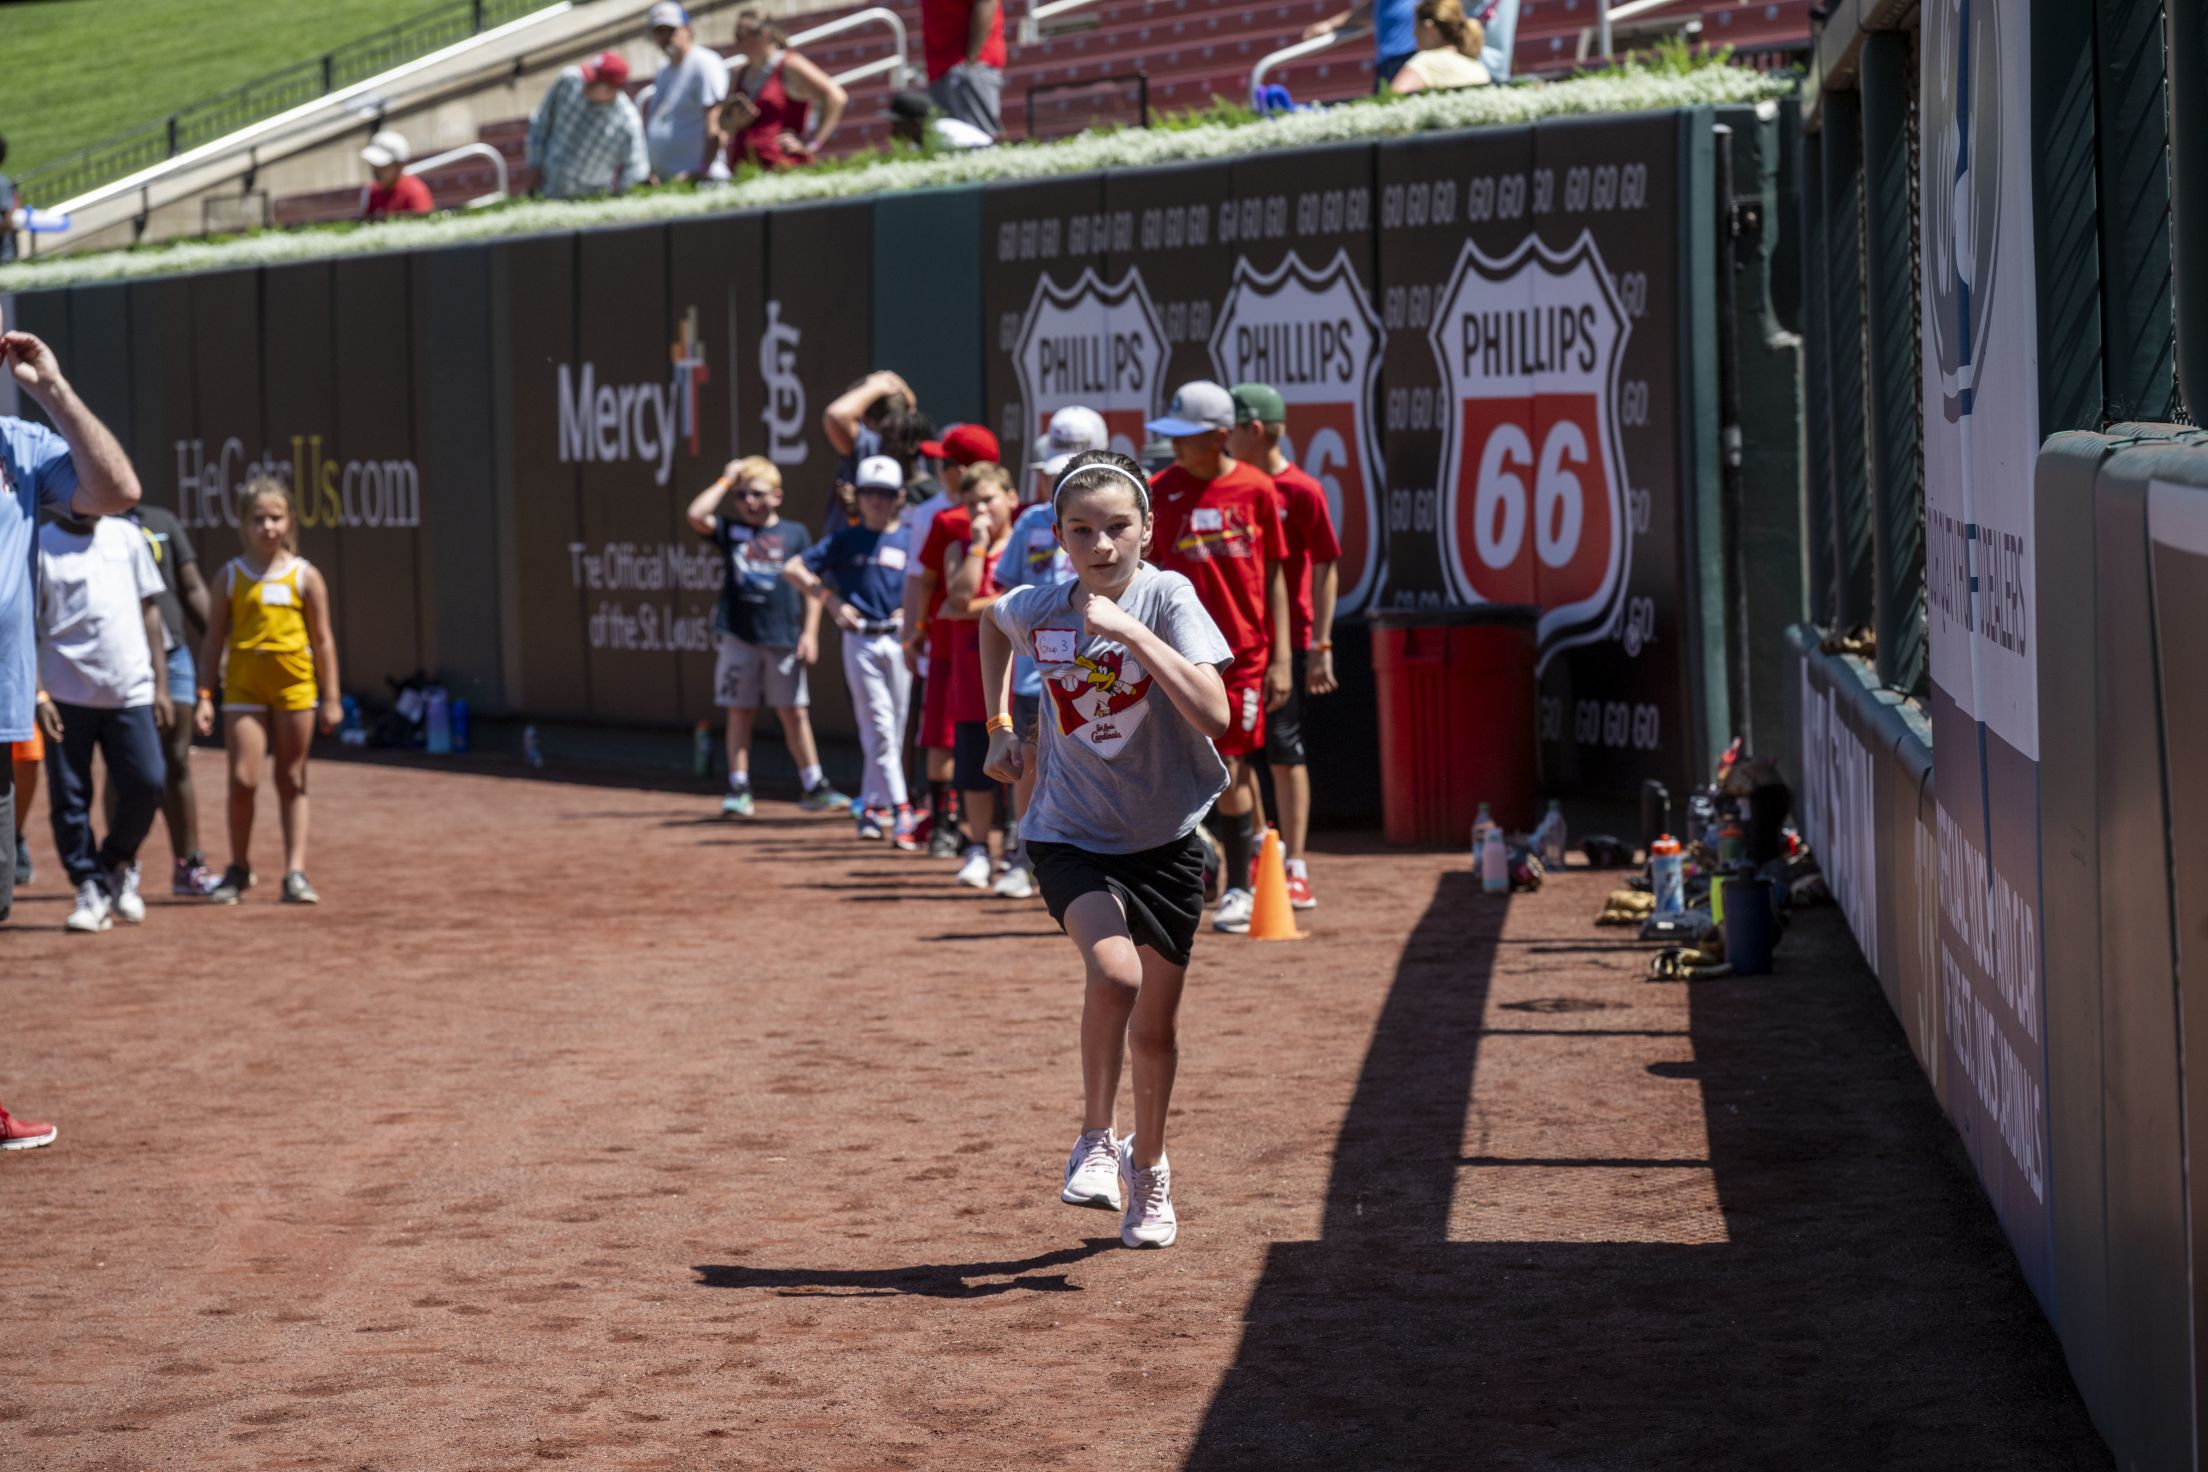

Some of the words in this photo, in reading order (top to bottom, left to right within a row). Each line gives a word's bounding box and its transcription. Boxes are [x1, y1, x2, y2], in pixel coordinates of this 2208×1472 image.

[1382, 183, 1405, 229] GO
[1406, 181, 1430, 227] GO
[1468, 176, 1495, 222] GO
[1497, 173, 1527, 219] GO
[1564, 166, 1591, 213] GO
[1592, 164, 1618, 211] GO
[1039, 331, 1144, 396] PHILLIPS
[1236, 318, 1354, 385] PHILLIPS
[1462, 303, 1597, 379] PHILLIPS
[558, 362, 678, 486] Mercy
[1473, 419, 1589, 570] 66
[1061, 640, 1069, 652] 3
[1091, 731, 1122, 743] Cardinals
[1575, 698, 1600, 745] GO
[1603, 700, 1629, 747] GO
[1994, 866, 2014, 1010] AND
[2014, 890, 2038, 1043] CAR
[1975, 994, 1998, 1122] OUIS
